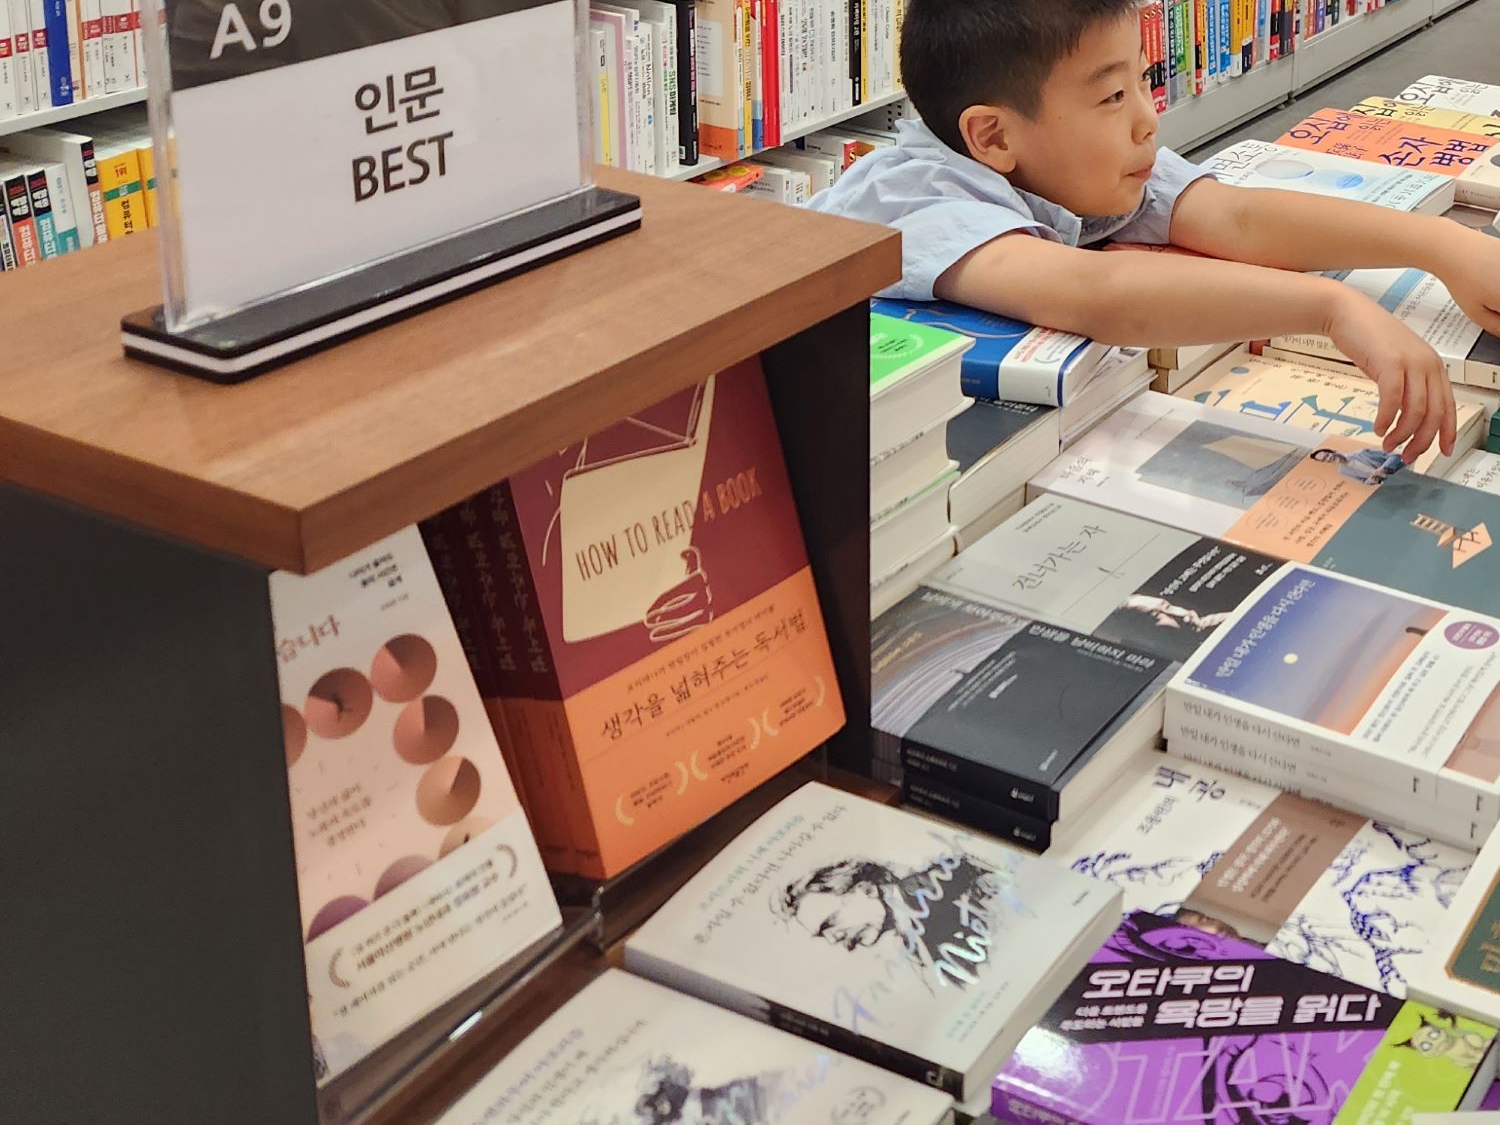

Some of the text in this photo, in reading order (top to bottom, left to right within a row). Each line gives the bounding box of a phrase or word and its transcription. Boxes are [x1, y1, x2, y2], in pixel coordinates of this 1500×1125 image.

[353, 64, 445, 135] 인문
[352, 131, 454, 203] BEST
[1377, 135, 1447, 166] 손자
[1429, 139, 1490, 167] 병법
[575, 466, 764, 581] HOW TO READ A BOOK
[1012, 523, 1109, 592] 건너가는 자
[1215, 578, 1317, 679] 만일 내가 인생을 다시 산다면
[601, 691, 667, 742] 생각을
[670, 647, 751, 705] 넓혀주는
[753, 610, 807, 653] 독서법
[1220, 740, 1247, 758] 인생을
[1248, 750, 1268, 764] 다시
[1268, 757, 1297, 772] 산다면
[1224, 714, 1250, 730] 인생을
[1252, 724, 1272, 740] 다시
[1272, 732, 1301, 748] 산다면
[1081, 963, 1257, 1001] 오타쿠의
[1152, 992, 1384, 1030] 욕망을 읽다
